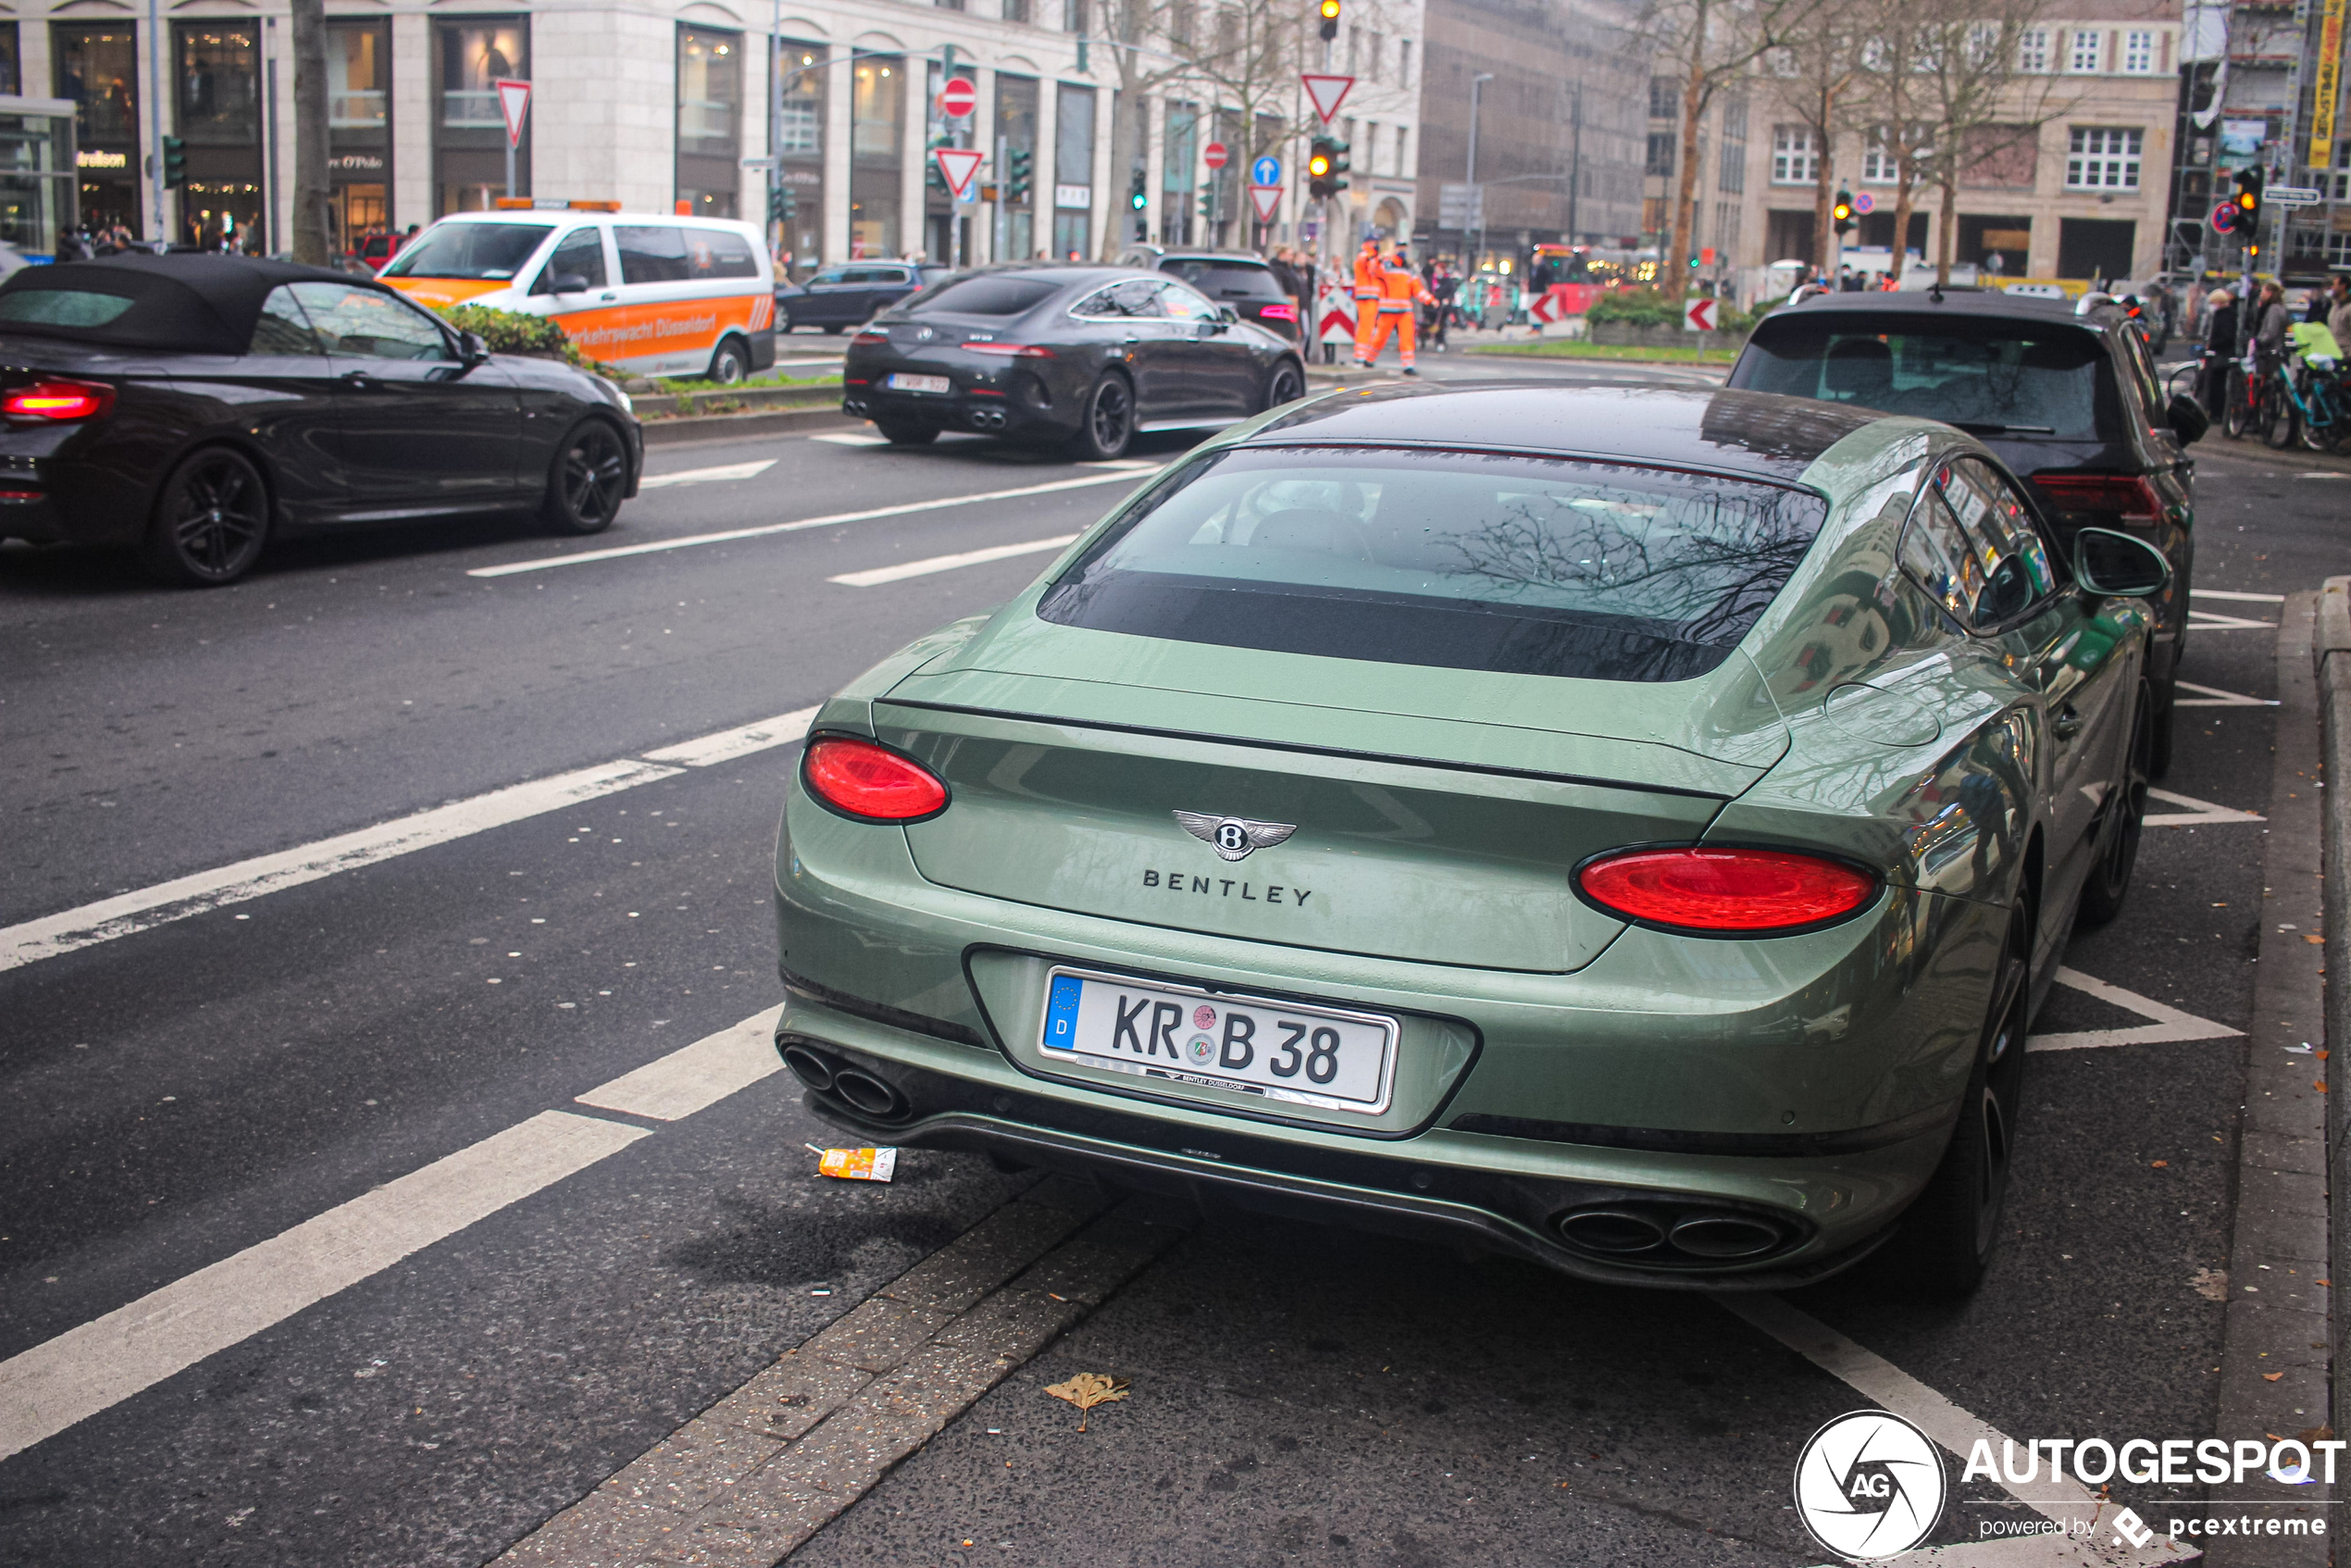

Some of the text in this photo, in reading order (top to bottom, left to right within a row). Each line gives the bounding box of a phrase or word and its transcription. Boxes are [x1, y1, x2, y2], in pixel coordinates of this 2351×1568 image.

[656, 313, 716, 340] Düsseldorf
[1219, 827, 1242, 850] B
[1143, 869, 1312, 906] BENTLEY
[1055, 1018, 1067, 1035] D
[1113, 994, 1184, 1059] KR
[1219, 1013, 1256, 1070] B
[1270, 1020, 1341, 1084] 38
[1182, 1075, 1207, 1085] BENTLEY
